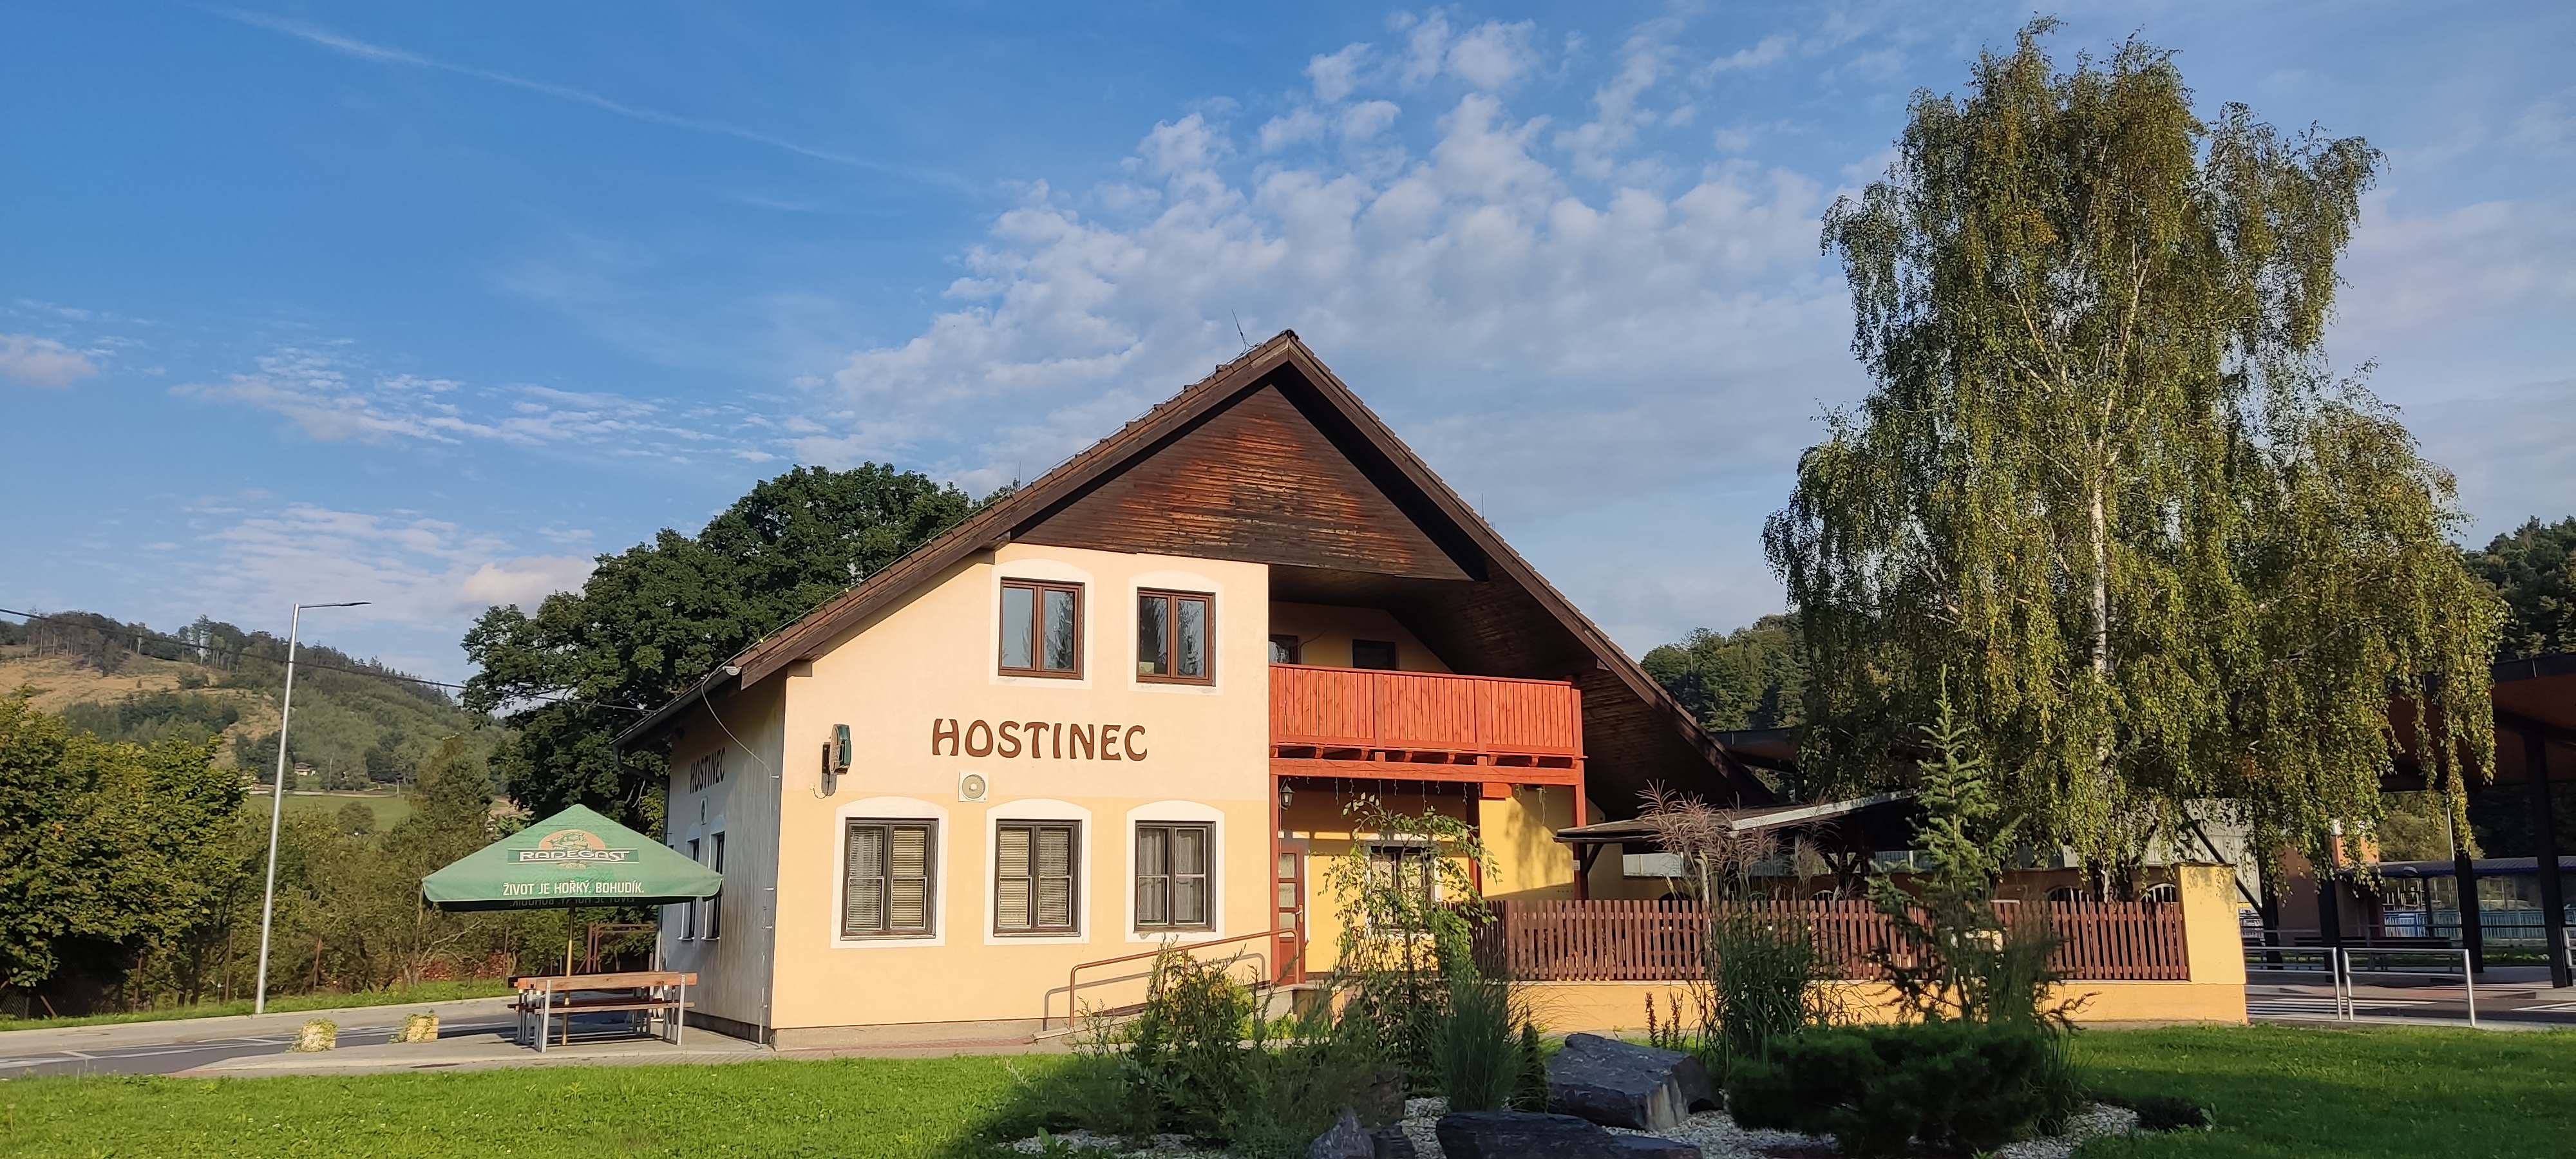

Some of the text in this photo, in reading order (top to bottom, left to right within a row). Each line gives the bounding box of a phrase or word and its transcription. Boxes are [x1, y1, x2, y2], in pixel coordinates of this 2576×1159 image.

[932, 719, 1148, 762] HOSTINEC
[689, 746, 726, 795] HOSTINEC
[519, 849, 630, 862] RADEGAST
[503, 880, 645, 896] ŽIVOT JE HOŘKÝ. BOHUDÍK.
